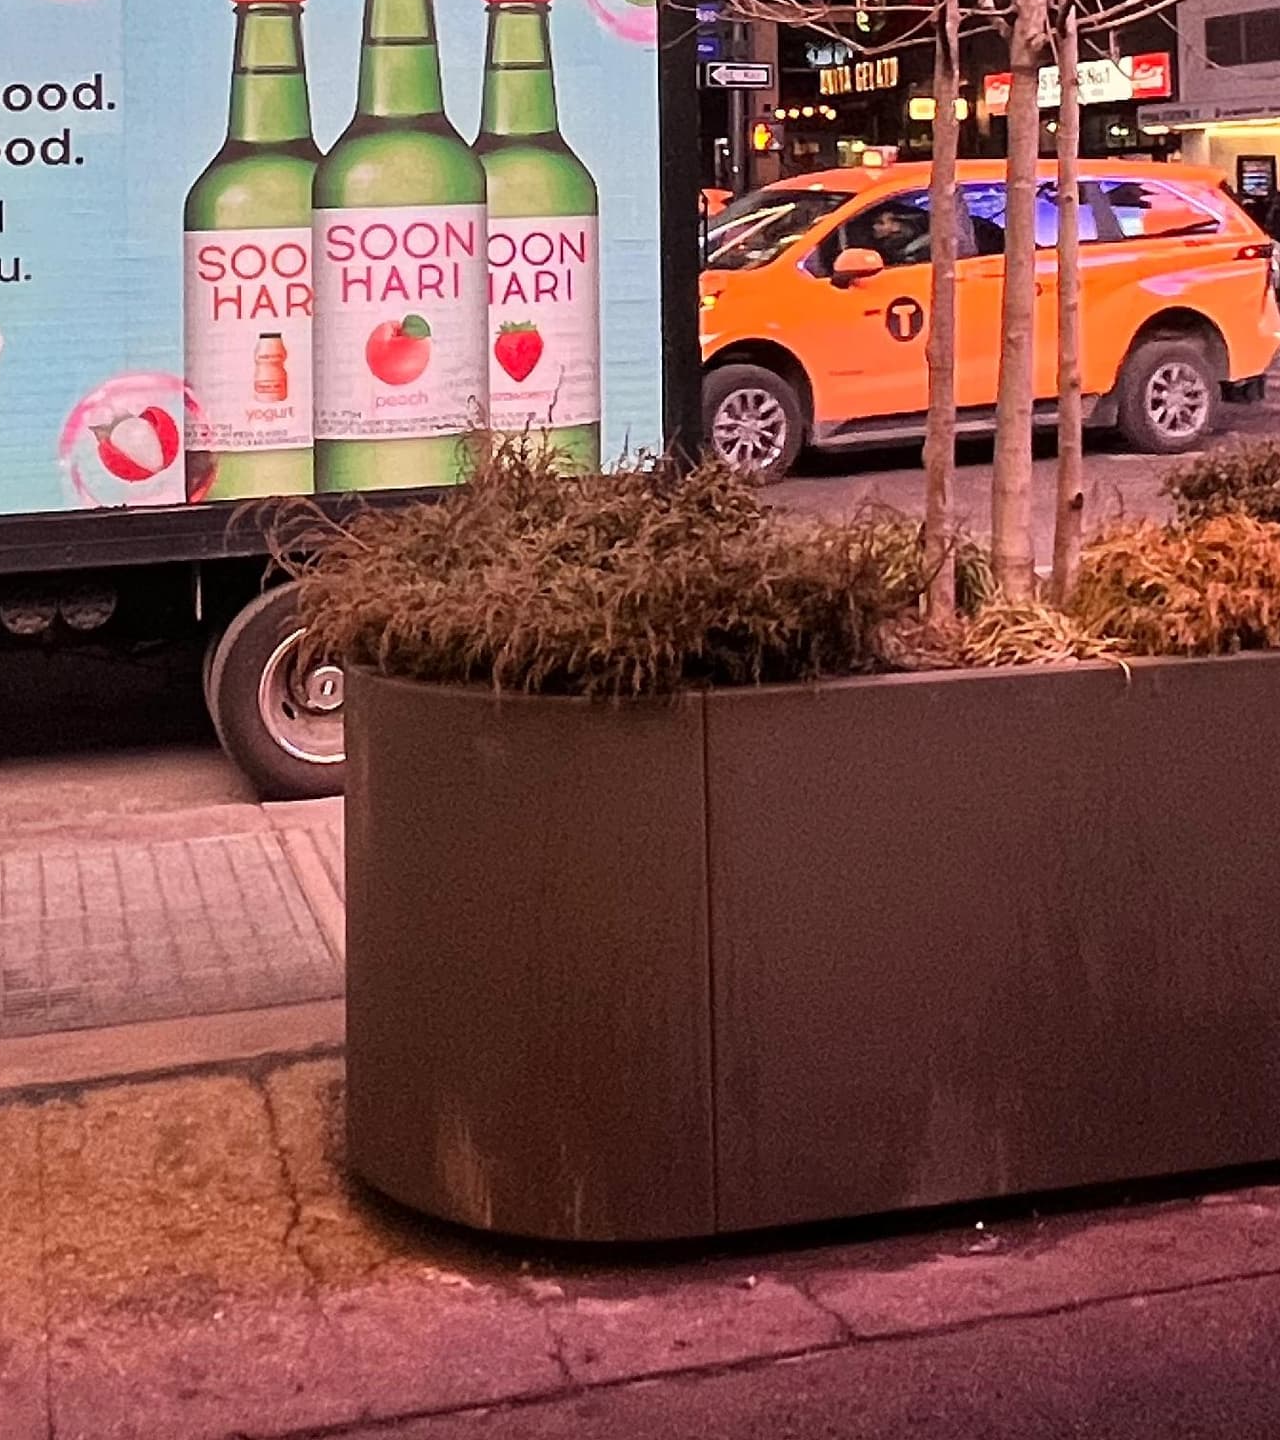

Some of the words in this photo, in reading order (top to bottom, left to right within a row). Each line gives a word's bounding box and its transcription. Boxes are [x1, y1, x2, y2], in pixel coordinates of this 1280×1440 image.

[326, 221, 474, 262] SOON
[342, 263, 459, 303] HARI
[892, 304, 916, 337] T
[244, 406, 295, 424] yogurt
[376, 390, 429, 409] peach
